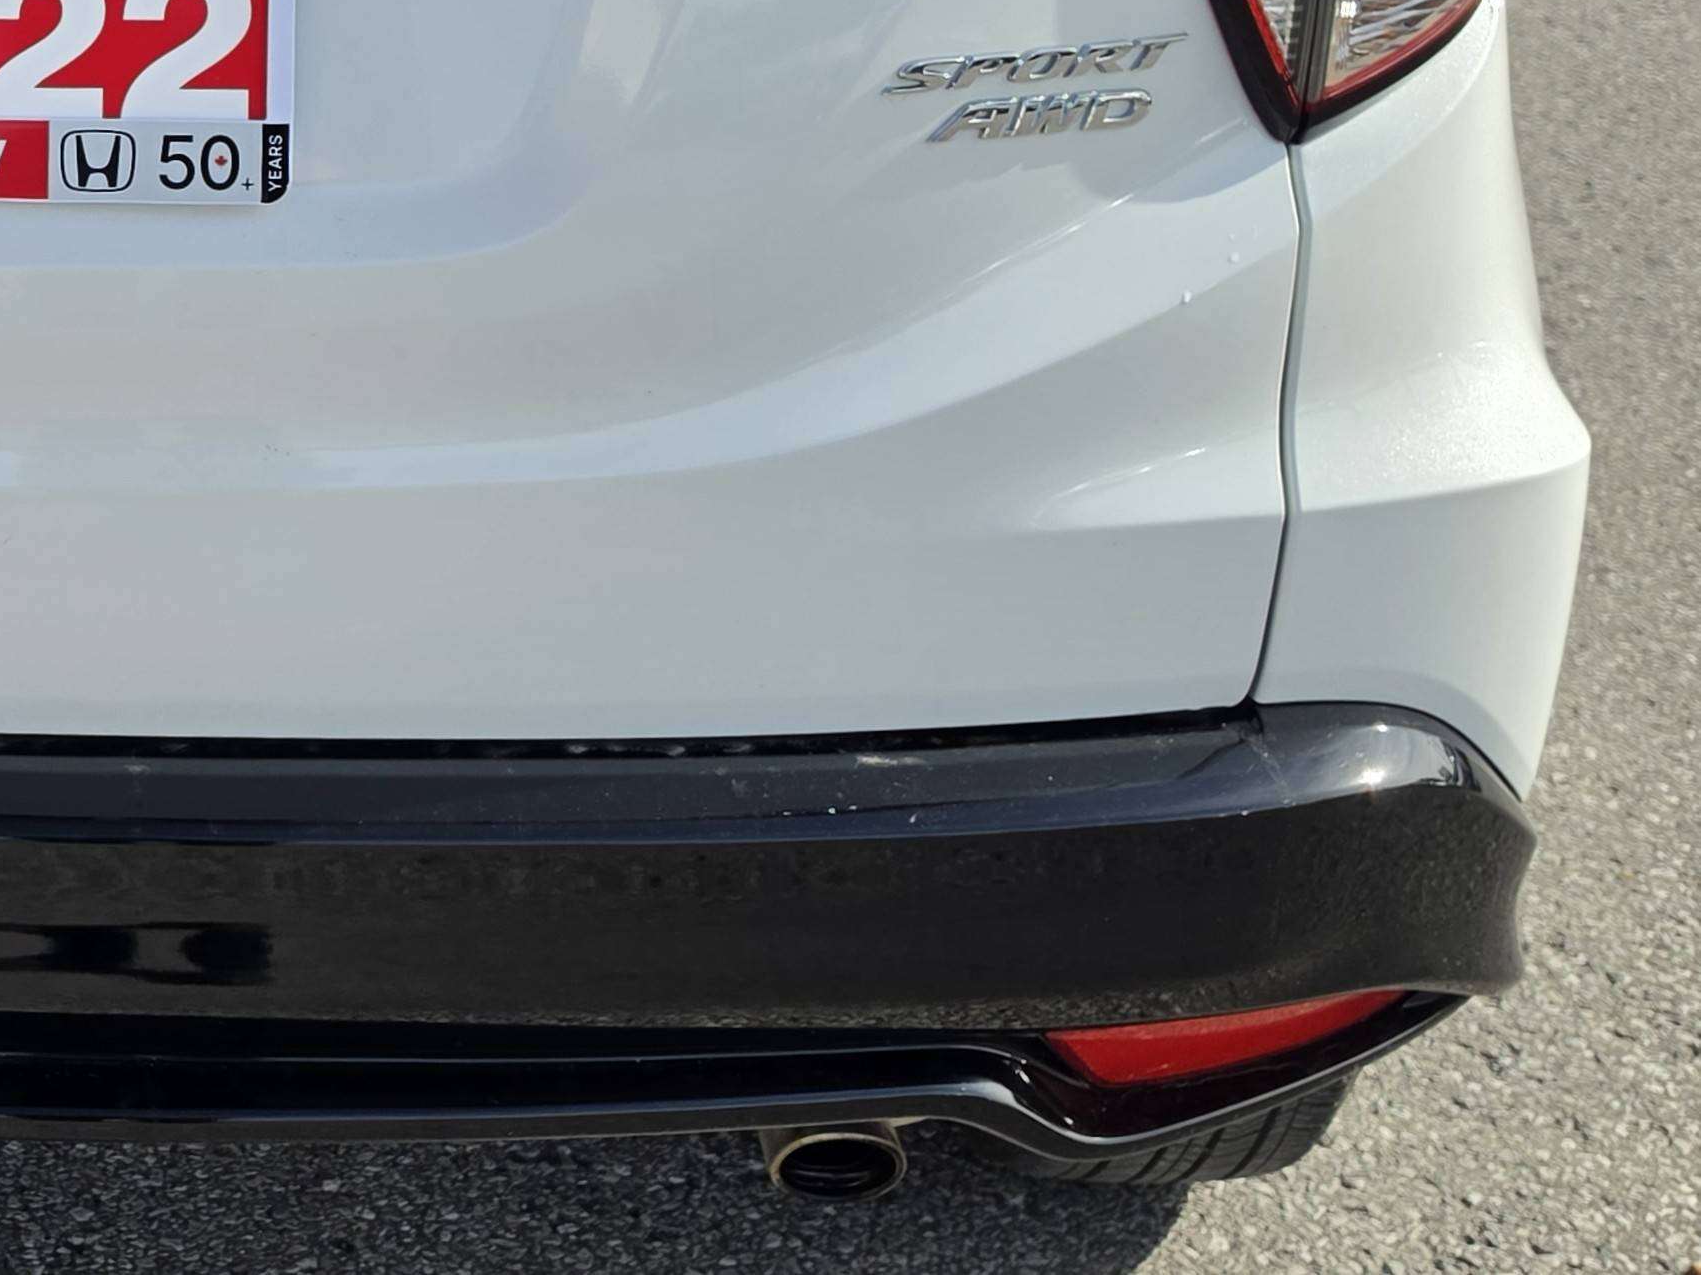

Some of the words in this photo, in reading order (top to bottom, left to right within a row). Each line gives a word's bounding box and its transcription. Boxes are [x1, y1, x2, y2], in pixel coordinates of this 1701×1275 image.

[881, 32, 1188, 95] SPORT
[925, 88, 1152, 142] AWD
[267, 134, 284, 192] YEARS
